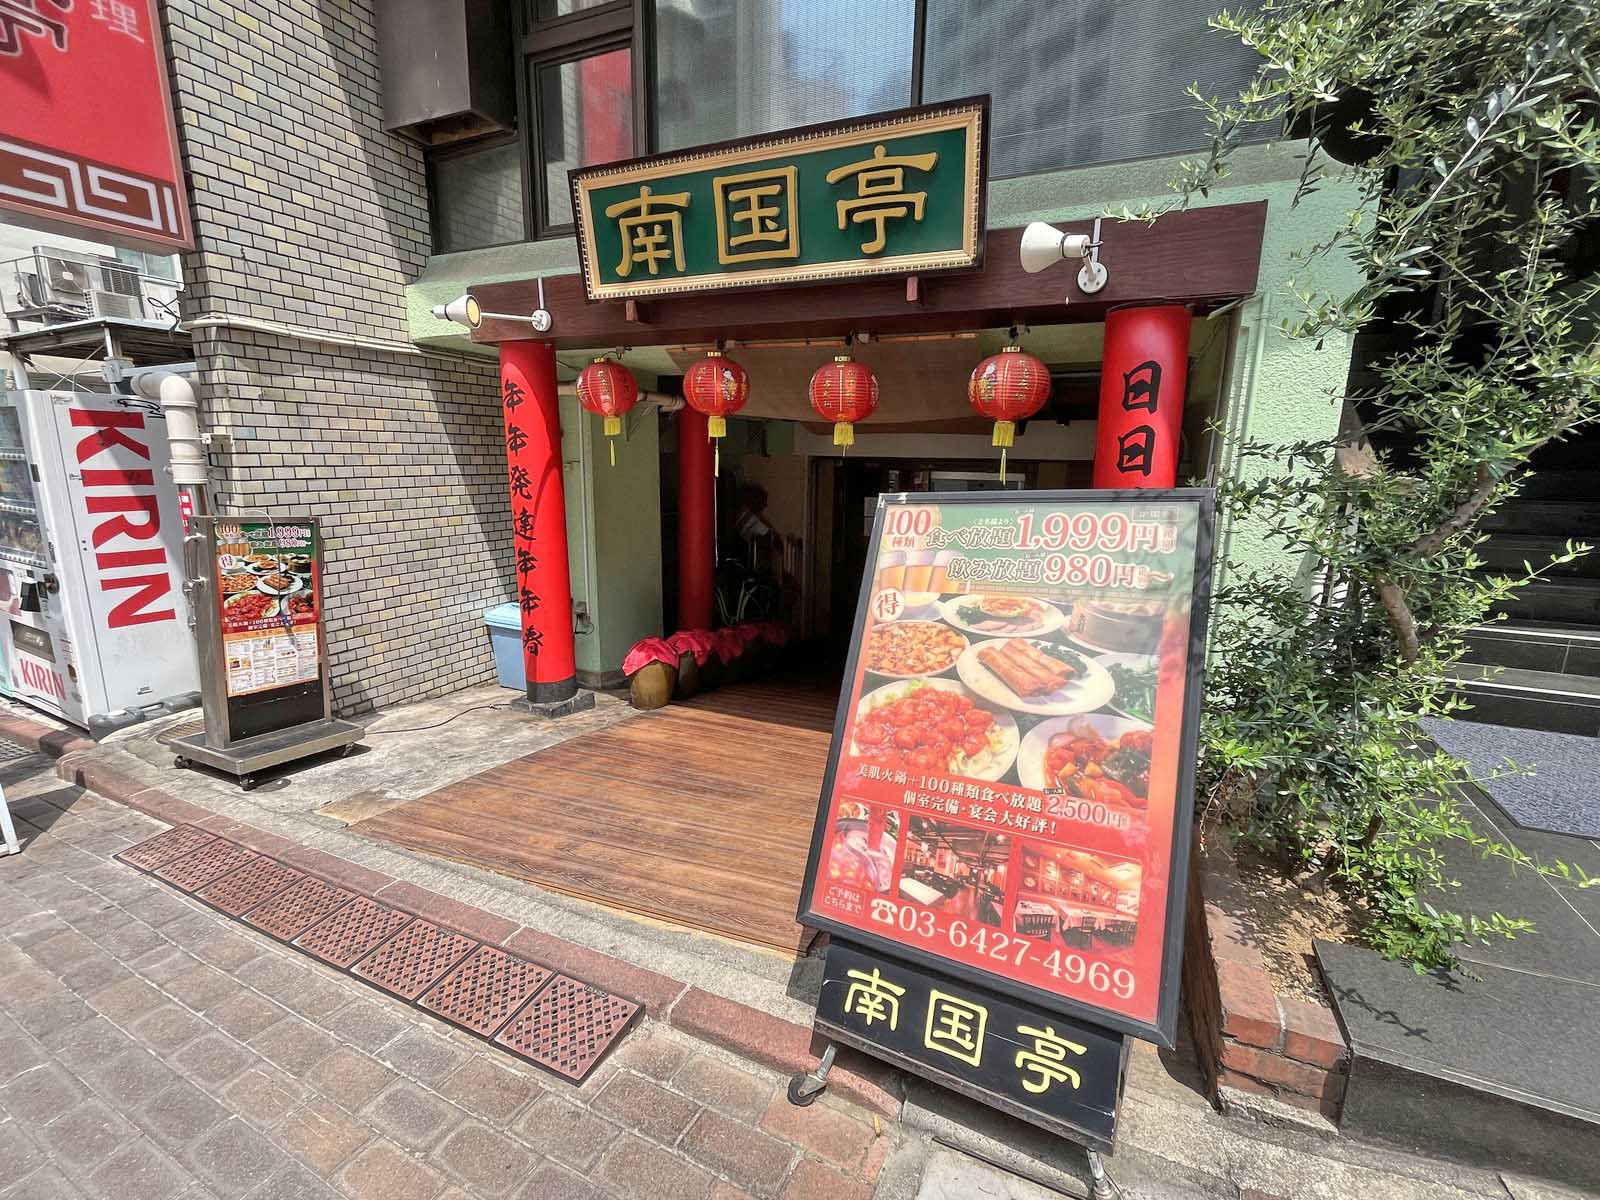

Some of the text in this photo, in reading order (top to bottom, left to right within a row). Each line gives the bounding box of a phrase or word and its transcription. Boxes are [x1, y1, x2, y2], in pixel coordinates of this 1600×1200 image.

[605, 145, 939, 278] 南国亭
[69, 407, 176, 629] KIRIN
[885, 509, 931, 536] 100
[926, 526, 1015, 550] 食べ放題
[947, 557, 1042, 584] 飲み放題
[876, 591, 899, 616] 得
[20, 658, 66, 701] KIRIN
[898, 904, 1137, 999] 03-6427-4969
[844, 968, 1088, 1094] 南国亭
